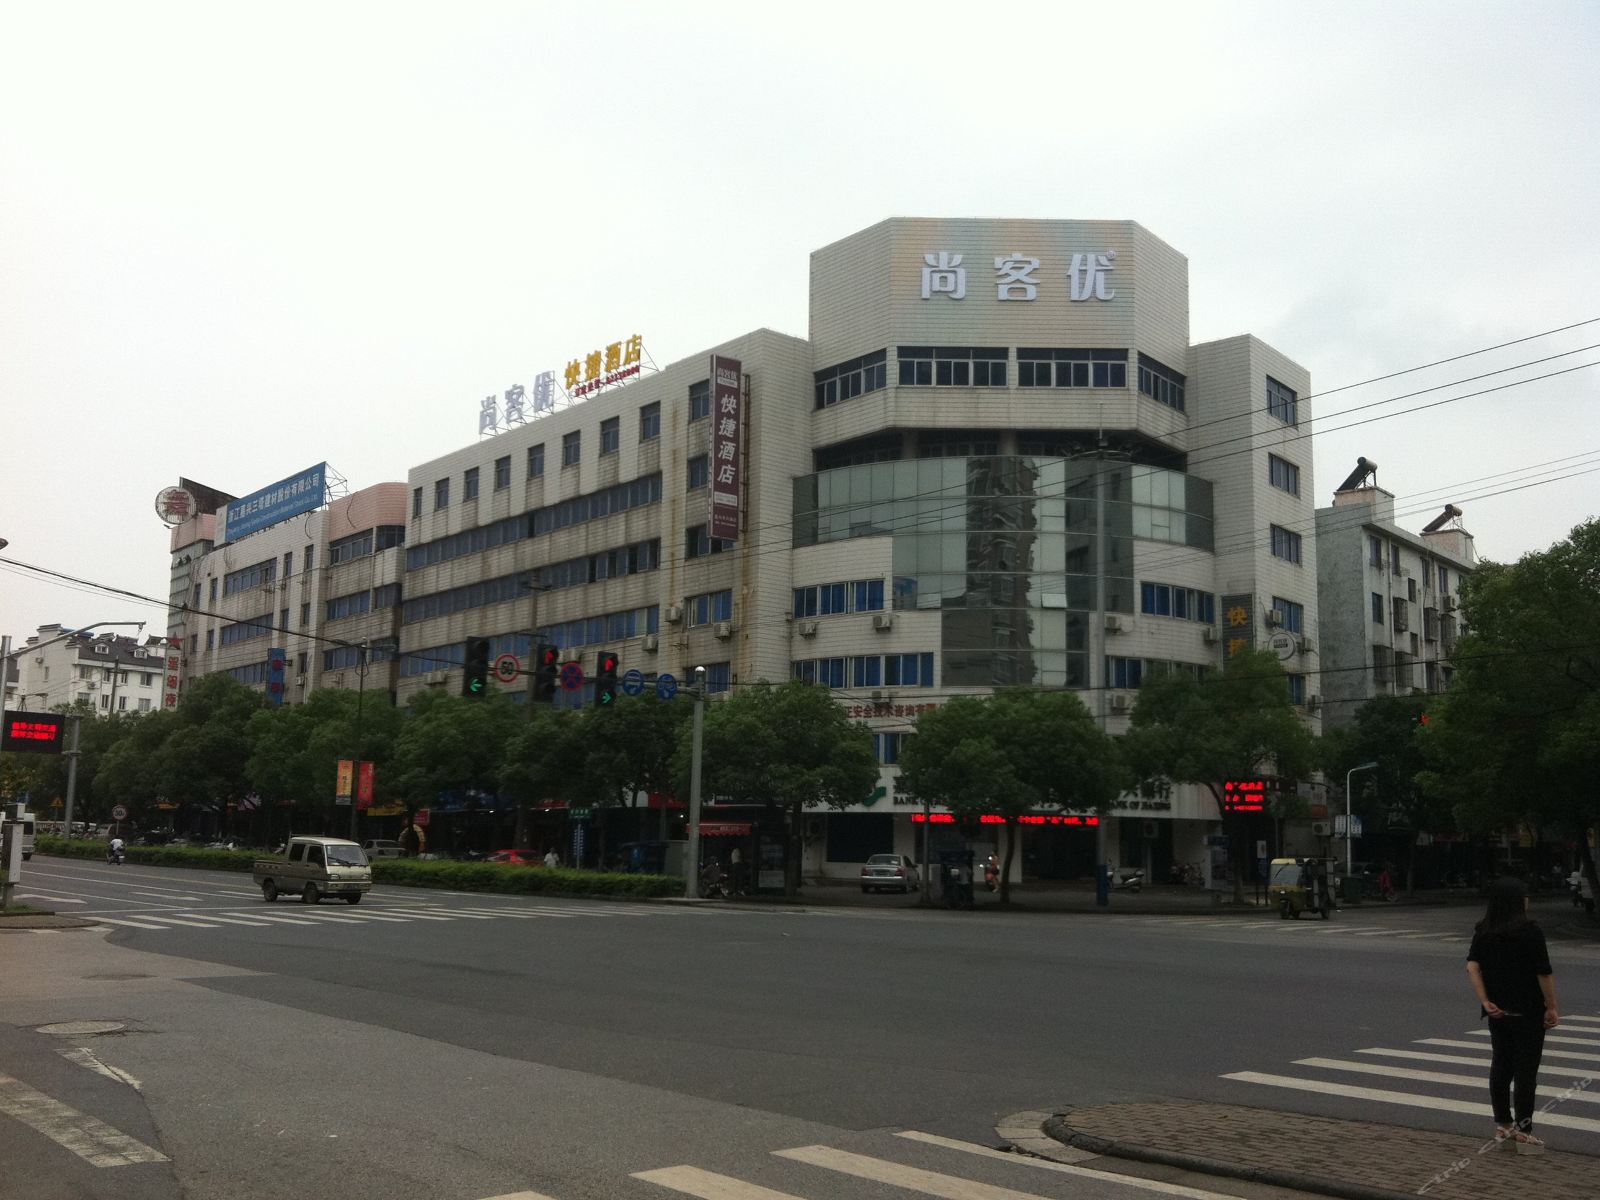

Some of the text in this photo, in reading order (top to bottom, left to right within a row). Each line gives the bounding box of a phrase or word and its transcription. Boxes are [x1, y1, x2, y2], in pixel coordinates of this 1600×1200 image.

[921, 251, 1115, 302] 尚客优
[479, 369, 555, 435] 尚客优
[564, 333, 642, 390] 快捷酒店
[717, 393, 737, 485] 快捷酒店
